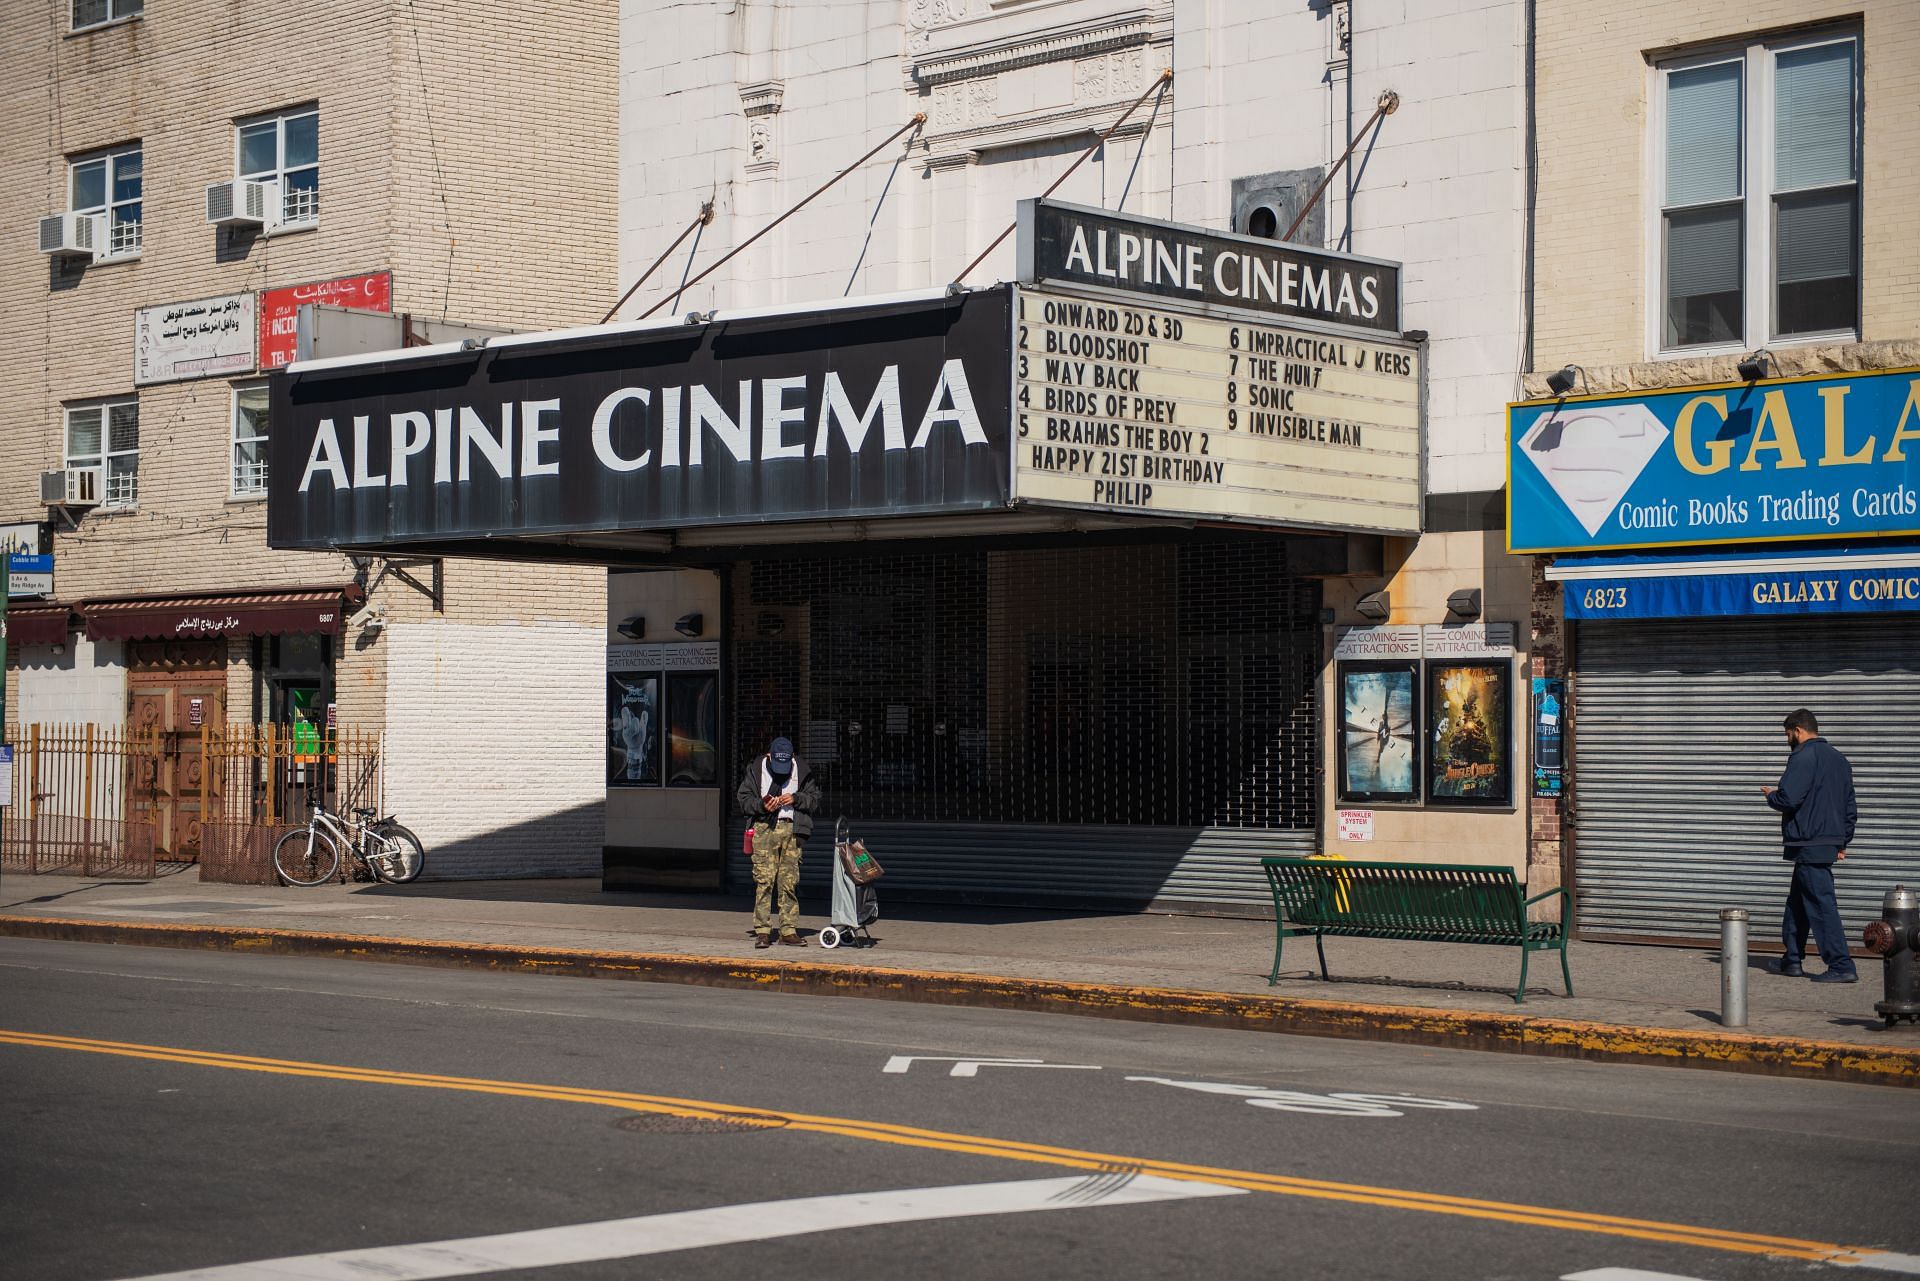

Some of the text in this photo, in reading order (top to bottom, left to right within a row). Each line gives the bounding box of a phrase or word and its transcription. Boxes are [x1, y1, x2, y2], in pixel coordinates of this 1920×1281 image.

[1065, 225, 1378, 319] ALPINE CINEMAS
[1019, 296, 1183, 341] 1 ONWARD 2D & 3D
[1018, 325, 1150, 364] 2 BLOODSHOT
[1230, 327, 1411, 376] 6 IMPRACTICAL J KERS
[1018, 355, 1140, 392] 3 WAY BACK
[1229, 355, 1322, 388] 7 THE HUNT
[1018, 384, 1177, 424] 4 BIRDS OF PREY
[1227, 381, 1294, 411] 8 SONIC
[298, 358, 989, 493] ALPINE CINEMA
[1018, 414, 1209, 455] 5 BRAHMS THE BOY 2
[1228, 409, 1361, 447] 9 INVISIBLE MAN
[1032, 445, 1224, 484] HAPPY 21ST BIRTHDAY
[1094, 479, 1153, 506] PHILIP
[1618, 484, 1917, 530] Comic Books Trading Cards
[1583, 577, 1920, 609] 6823 GALAXY COMIC
[679, 648, 705, 656] COMING
[1345, 644, 1409, 654] ATTRACTIONS
[1358, 632, 1397, 642] COMING
[1435, 642, 1501, 652] ATTRACTIONS
[1448, 631, 1487, 641] COMING
[613, 659, 656, 667] ATTRACTIONS
[621, 649, 648, 657] COMING
[670, 657, 712, 665] ATTRACTIONS
